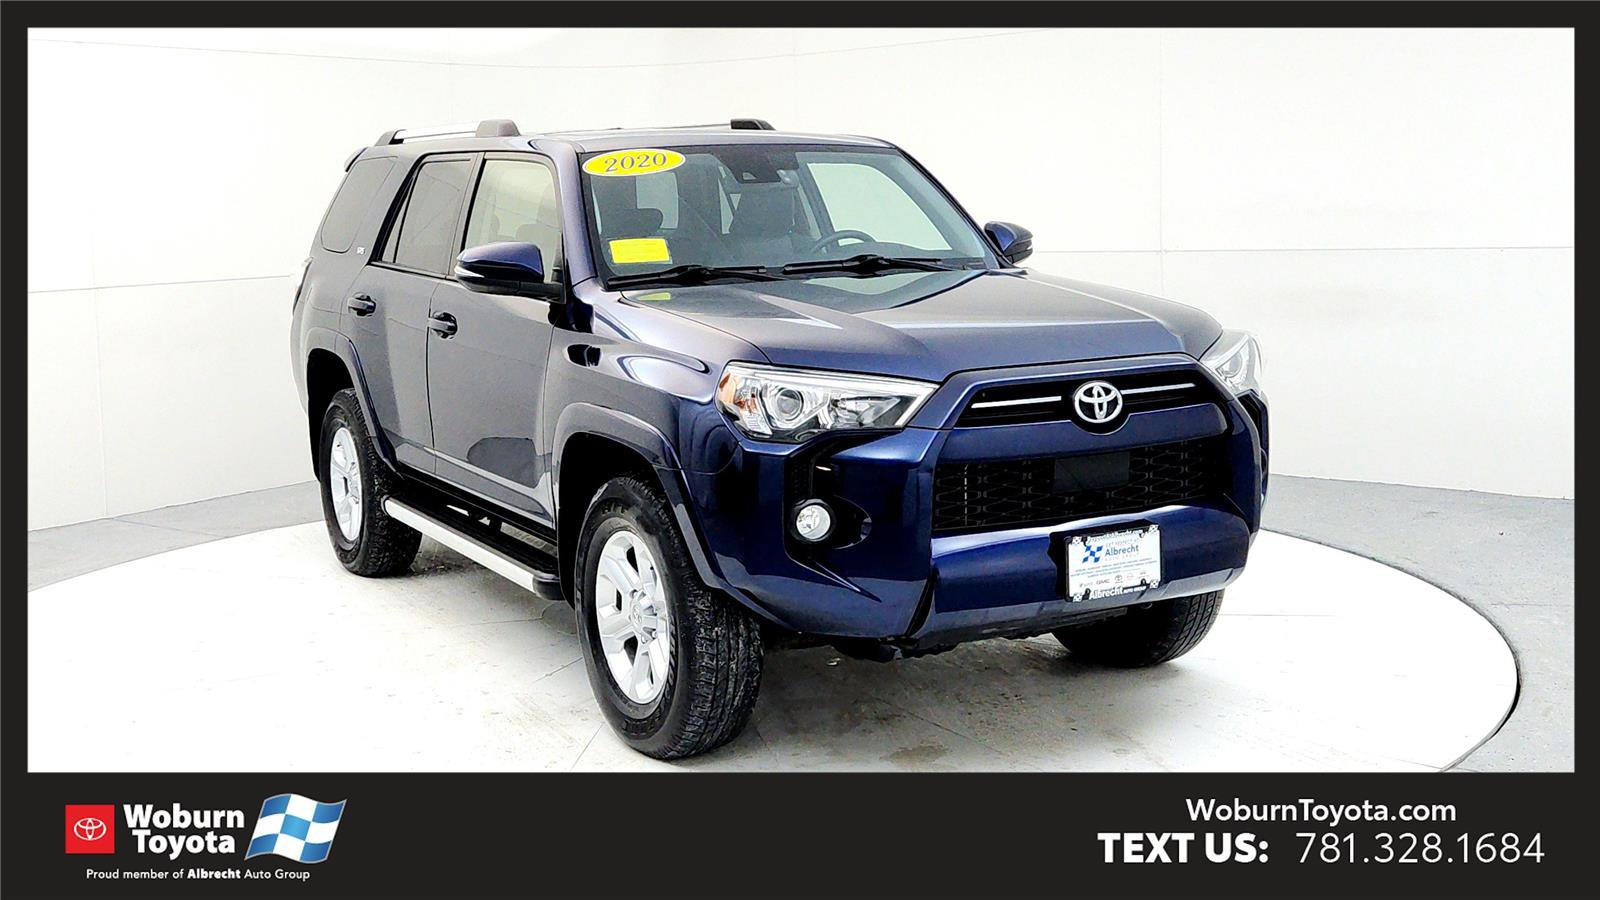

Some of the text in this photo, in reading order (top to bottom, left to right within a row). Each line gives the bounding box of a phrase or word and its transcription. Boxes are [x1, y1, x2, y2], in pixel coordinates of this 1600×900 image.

[604, 152, 667, 173] 2020
[1104, 544, 1140, 557] Albrecht
[1089, 586, 1123, 600] Albrecht
